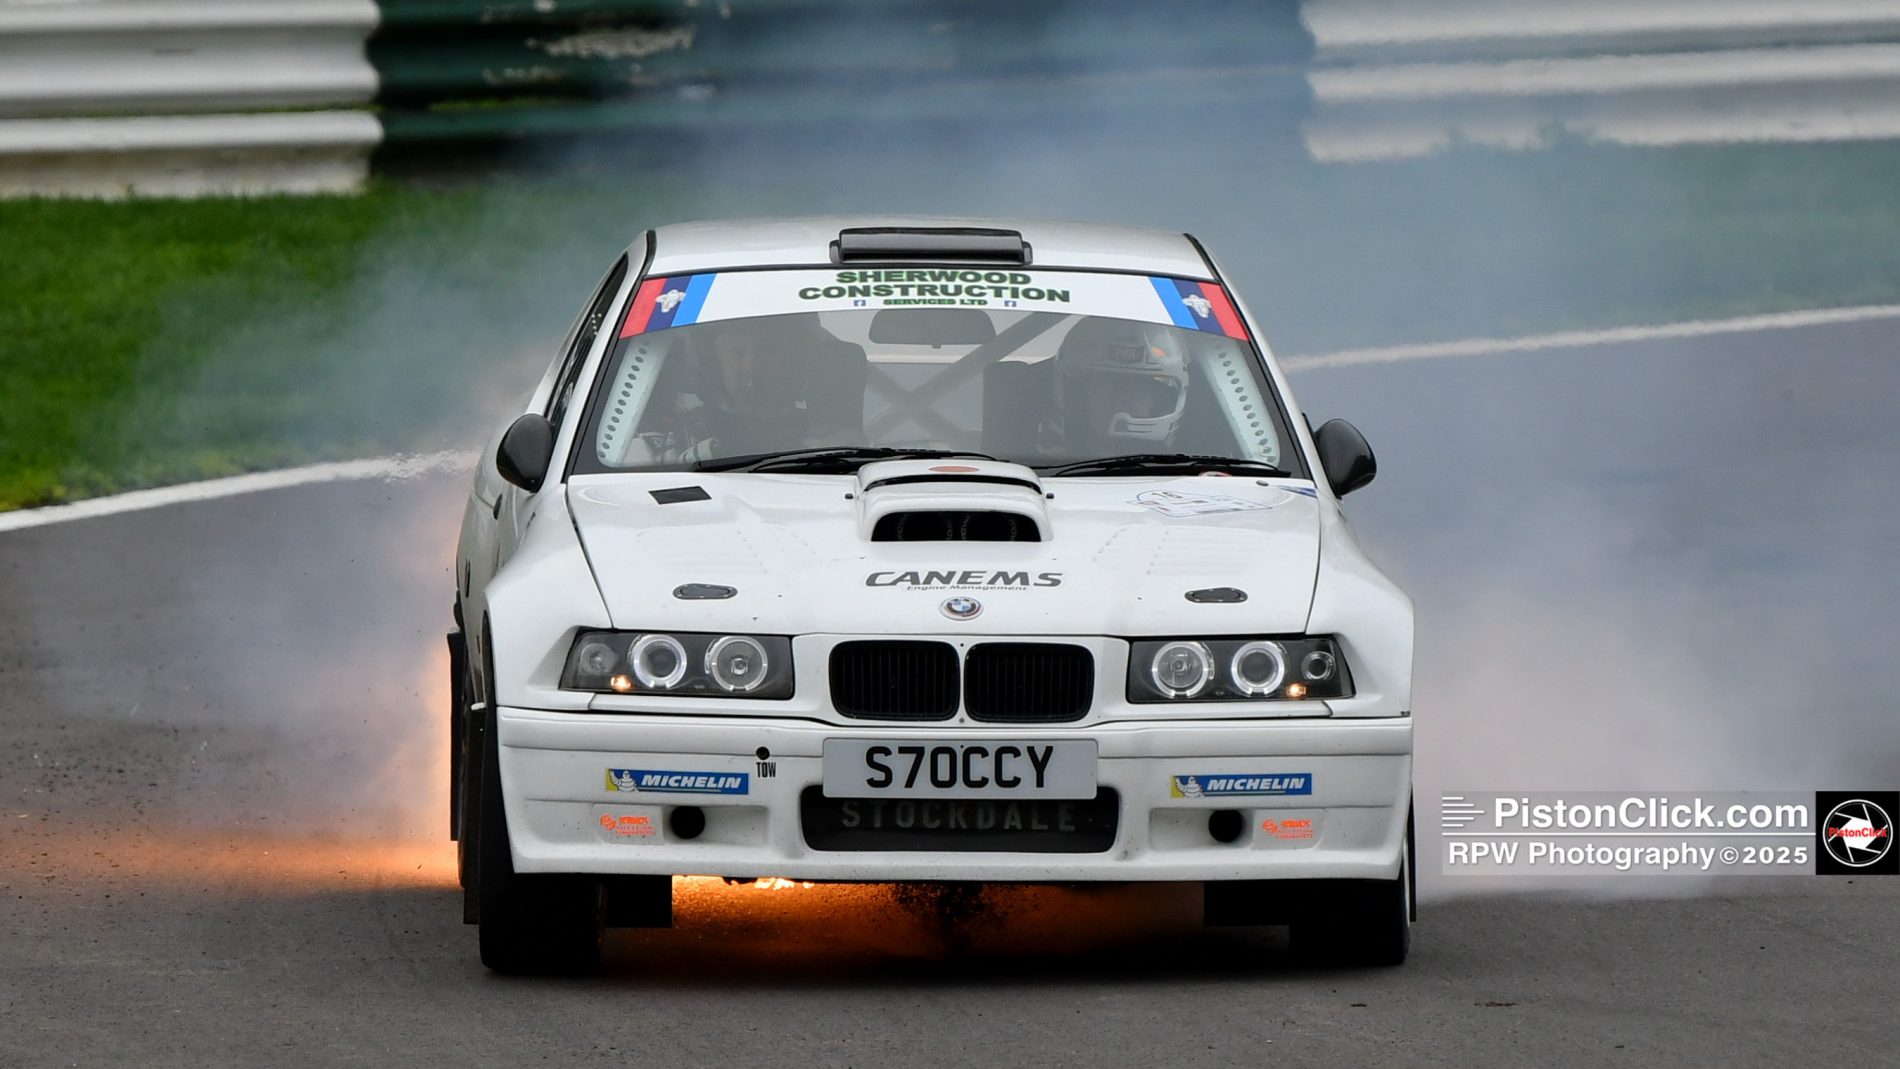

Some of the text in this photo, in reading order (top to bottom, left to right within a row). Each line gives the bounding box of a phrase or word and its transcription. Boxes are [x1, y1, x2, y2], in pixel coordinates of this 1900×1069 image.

[835, 270, 1032, 286] SHERWOOD
[798, 283, 1071, 303] CONSTRUCTION
[882, 298, 956, 306] SERVICES
[865, 570, 1063, 587] CANEMS
[756, 761, 777, 778] TOW
[865, 745, 1054, 789] S70CCY
[641, 773, 741, 789] MICHELIN
[1207, 777, 1305, 791] MICHELIN
[841, 801, 1076, 831] STOCKDALE
